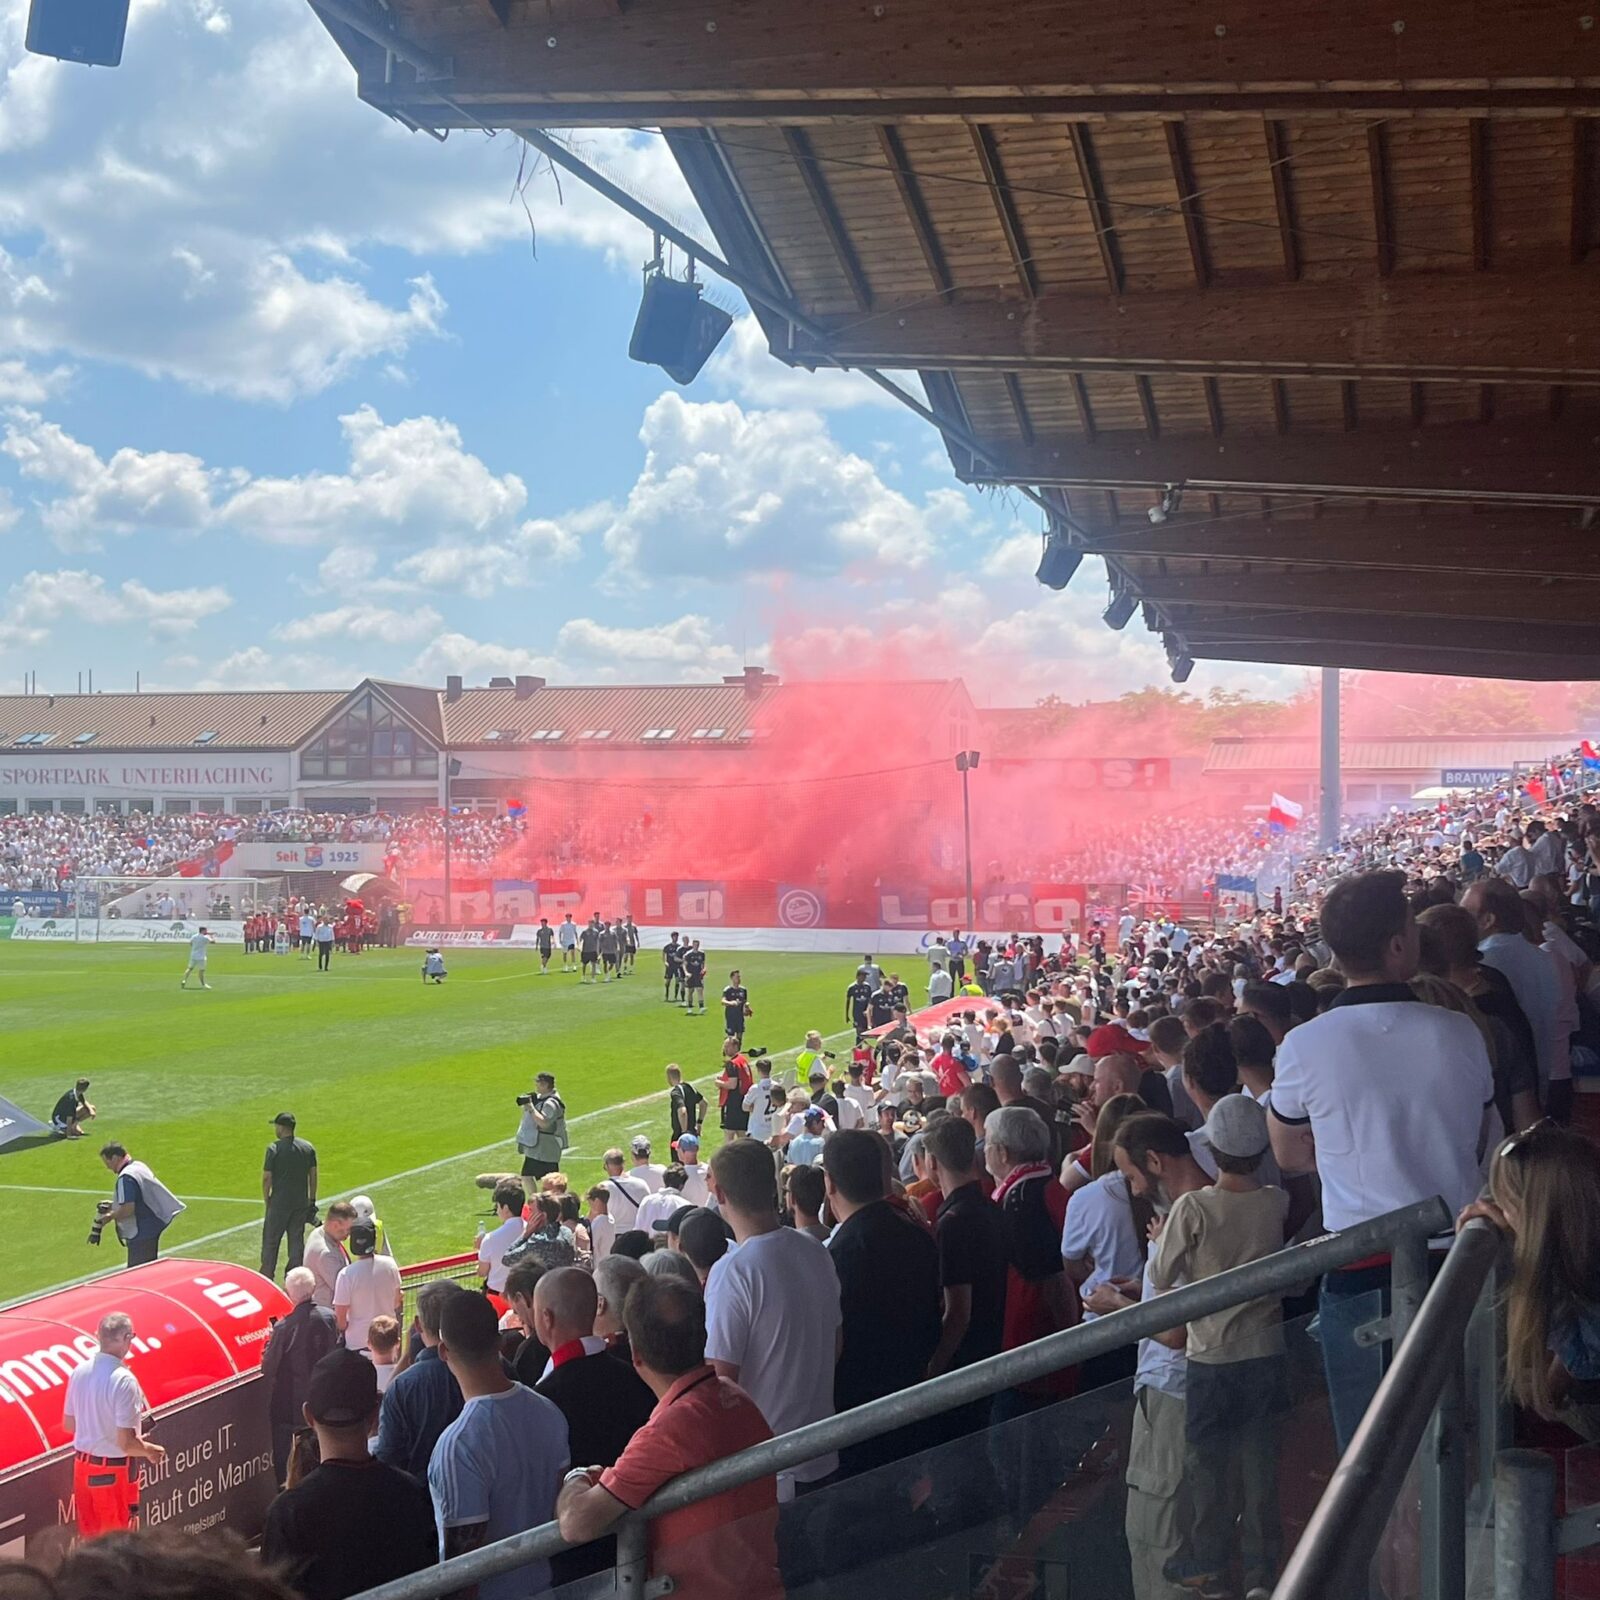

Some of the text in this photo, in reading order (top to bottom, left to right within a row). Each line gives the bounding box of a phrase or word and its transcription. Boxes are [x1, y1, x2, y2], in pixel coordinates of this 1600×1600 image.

[2, 767, 273, 785] SPORTPARK UNTERHACHING
[276, 850, 359, 862] Seit 1925
[142, 926, 193, 941] Alpenbau
[139, 1454, 171, 1491] äuft
[175, 1439, 213, 1473] eure
[217, 1423, 237, 1454] IT.
[146, 1488, 183, 1528] läuft
[188, 1476, 213, 1508] die
